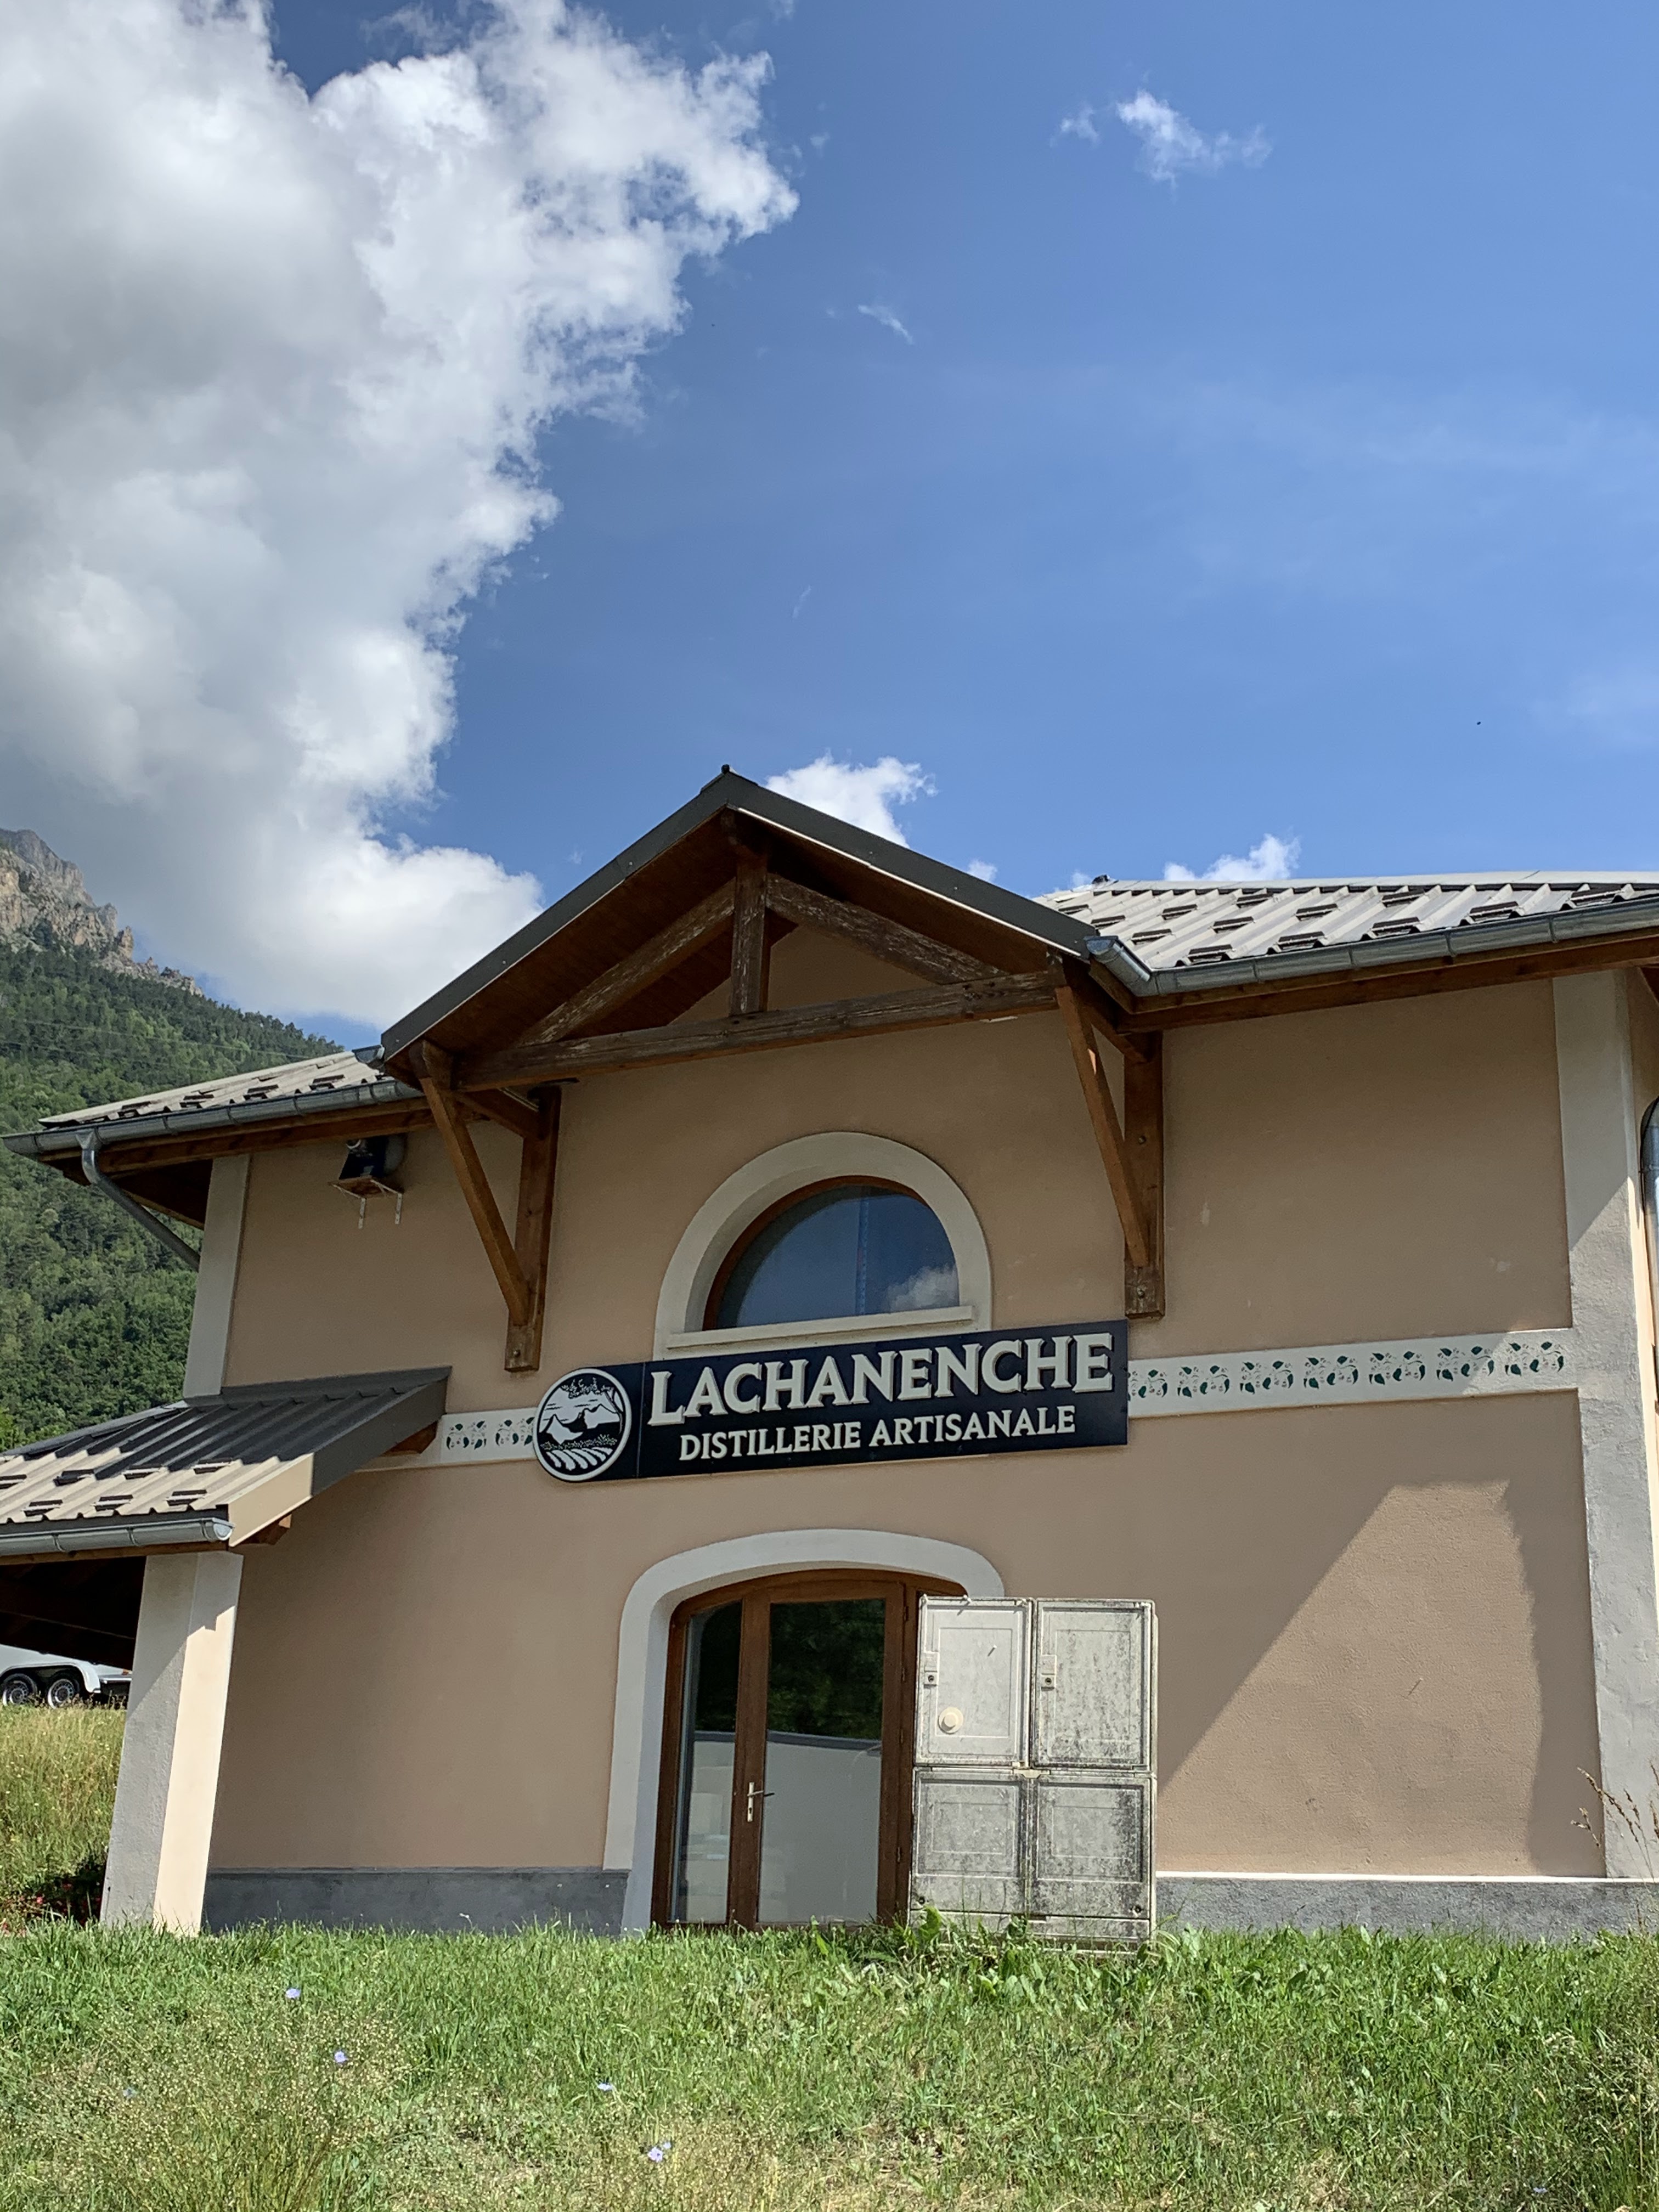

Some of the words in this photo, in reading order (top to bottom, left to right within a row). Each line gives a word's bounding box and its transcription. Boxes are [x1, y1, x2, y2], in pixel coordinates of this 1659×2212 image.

[648, 1332, 1113, 1426] LACHANENCHE
[679, 1421, 861, 1460] DISTILLERIE
[868, 1406, 1075, 1447] ARTISANALE
